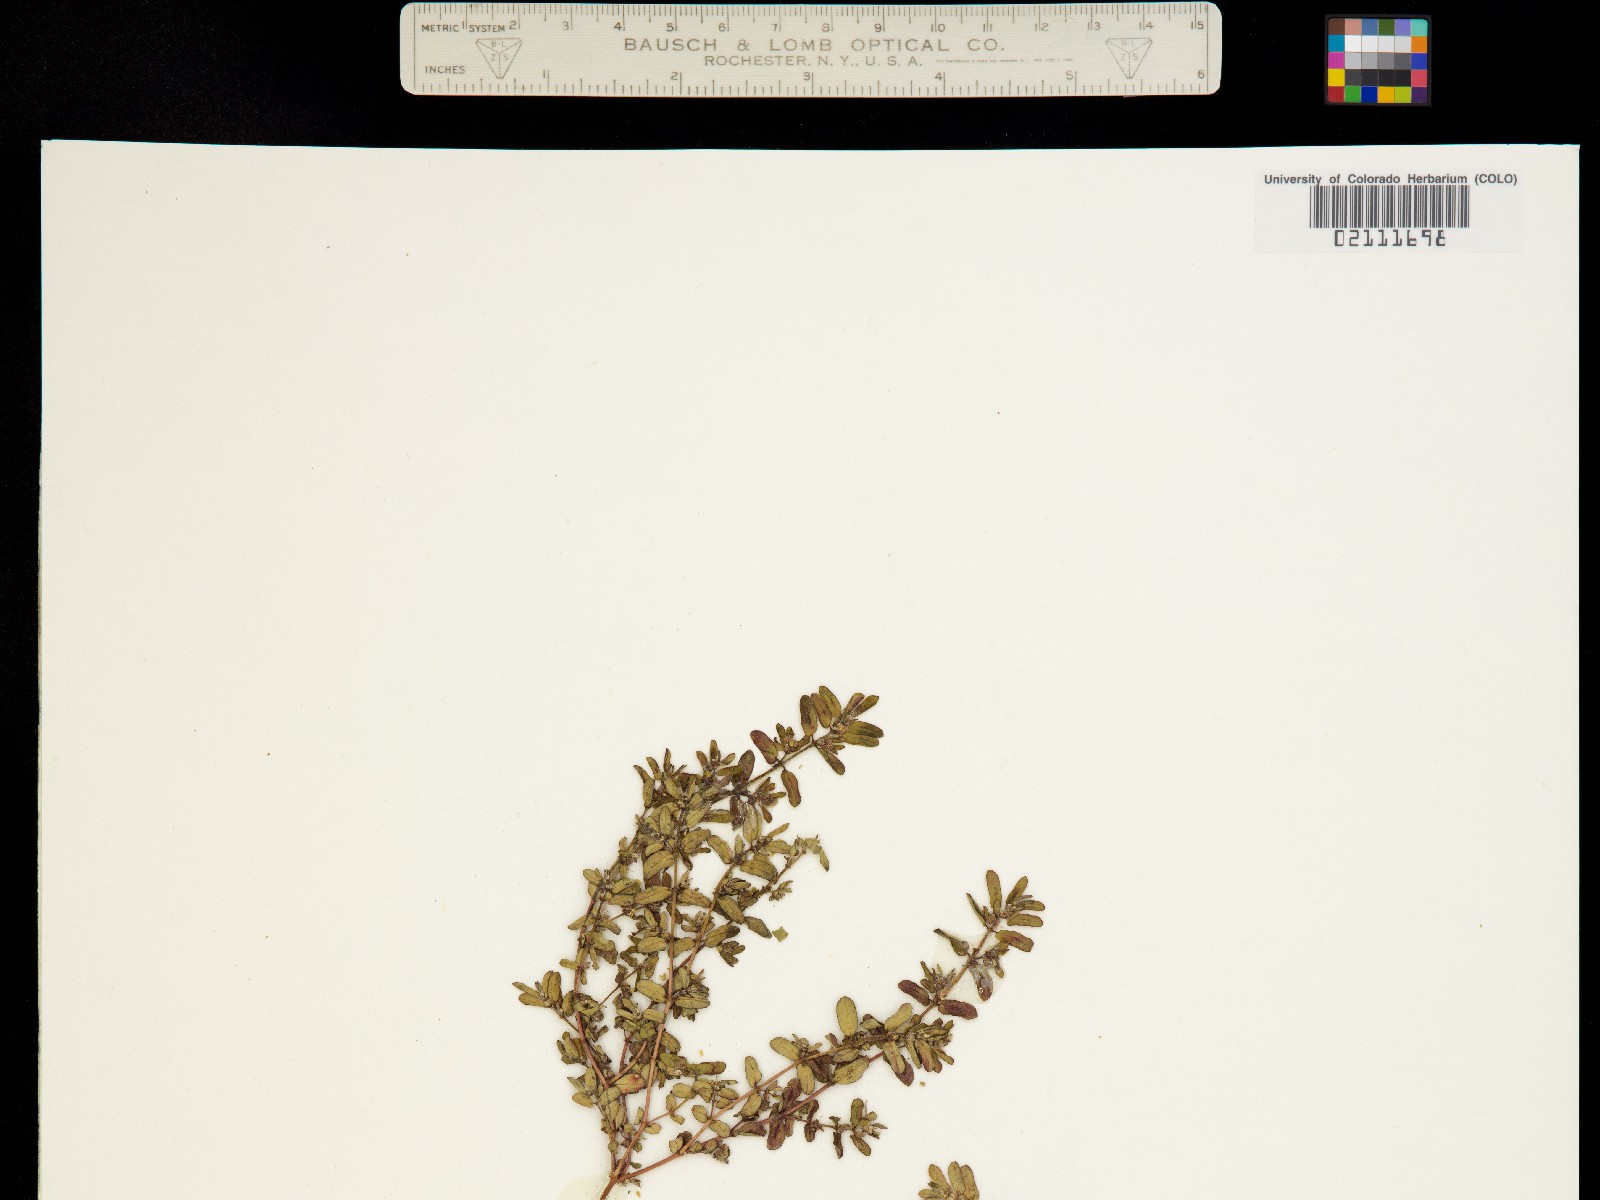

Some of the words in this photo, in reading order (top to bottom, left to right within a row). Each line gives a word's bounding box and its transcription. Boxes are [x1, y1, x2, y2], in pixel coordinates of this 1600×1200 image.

[420, 23, 460, 33] METRIC
[468, 23, 506, 33] SYSTEM
[508, 20, 518, 30] 2
[562, 21, 570, 31] 3
[613, 21, 623, 32] 4
[665, 22, 675, 33] 5
[718, 22, 726, 33] 6
[772, 23, 779, 33] 7
[874, 22, 882, 33] 9
[624, 37, 717, 52] BAUSCH
[736, 38, 750, 52] &
[769, 37, 833, 52] LOMB
[850, 38, 950, 52] OPTICAL
[966, 38, 1005, 52] CO.
[425, 65, 466, 75] INCHES
[1197, 69, 1206, 79] 6
[671, 72, 679, 81] 2
[803, 72, 812, 81] 3
[934, 72, 943, 81] 4
[1066, 70, 1074, 81] 5
[1264, 173, 1322, 187] University
[1328, 173, 1341, 184] of
[1347, 173, 1401, 184] Colorado
[1407, 173, 1468, 184] Herbarium
[1474, 173, 1518, 187] (COLO)
